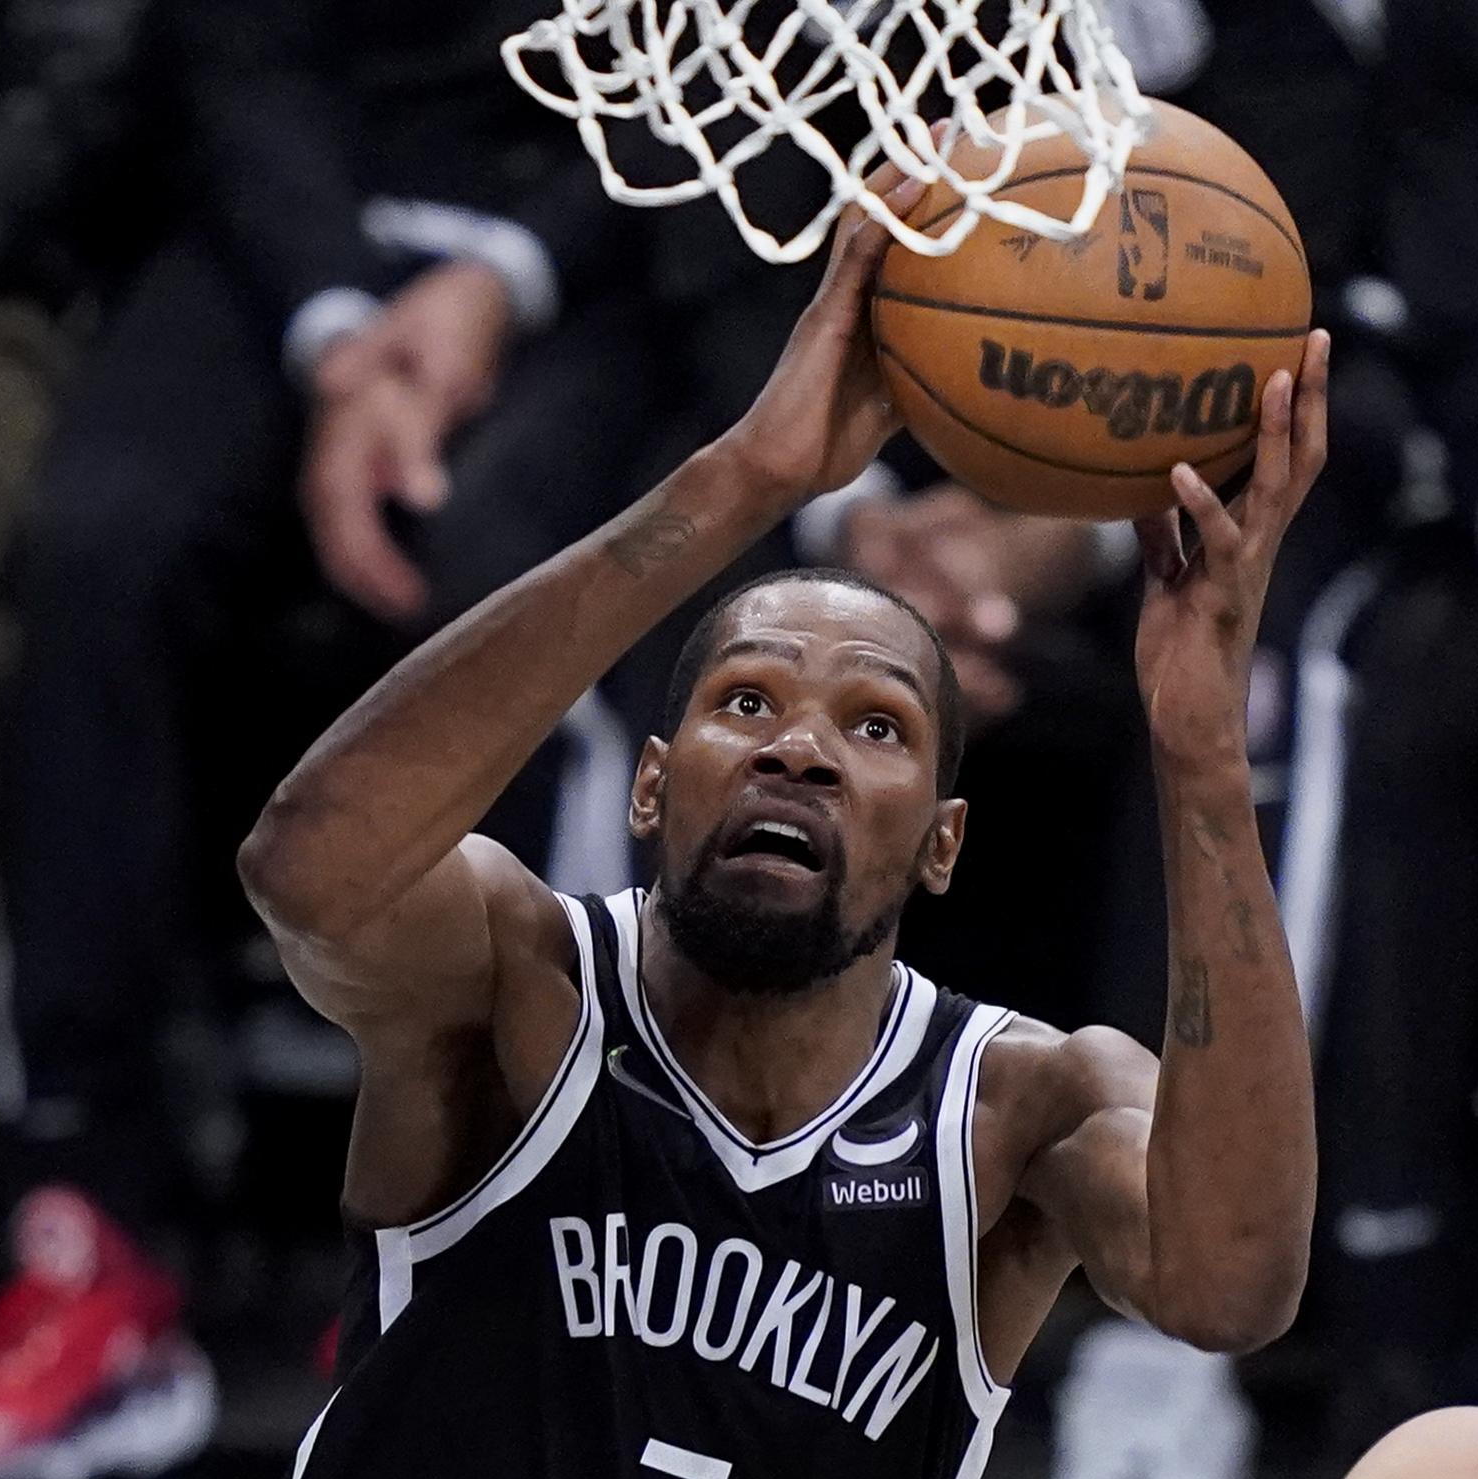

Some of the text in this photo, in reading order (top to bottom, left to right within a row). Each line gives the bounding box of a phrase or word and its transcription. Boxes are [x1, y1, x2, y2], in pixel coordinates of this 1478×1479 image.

[980, 338, 1257, 443] Wilson
[830, 1176, 921, 1205] Webull
[550, 1212, 939, 1441] BROOKLYN
